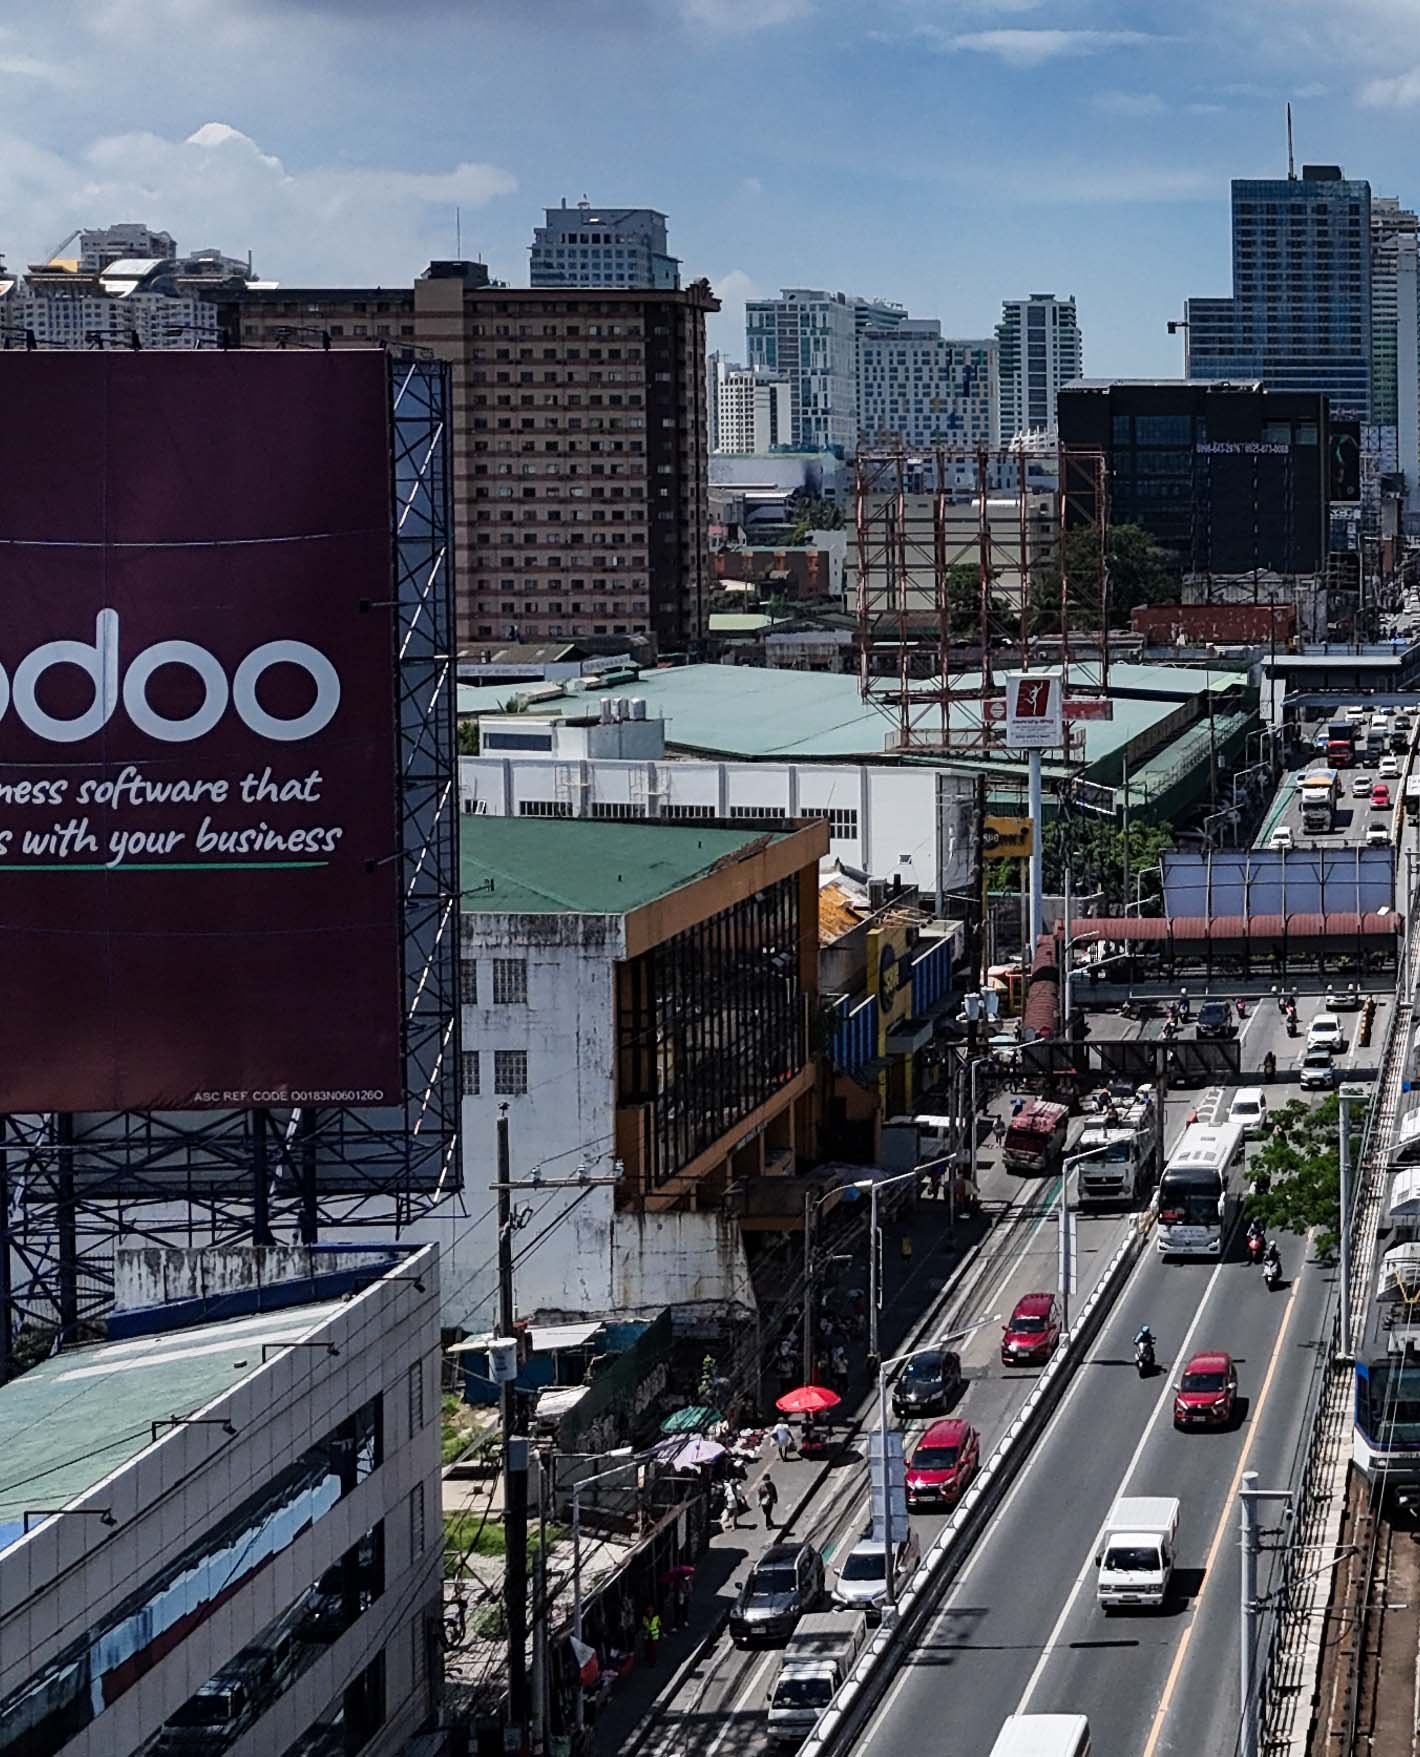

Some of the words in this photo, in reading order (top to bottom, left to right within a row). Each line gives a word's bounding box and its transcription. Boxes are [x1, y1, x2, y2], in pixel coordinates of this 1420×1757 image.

[0, 608, 341, 742] doo
[76, 766, 229, 811] software
[239, 766, 323, 804] that
[22, 817, 99, 857] with
[105, 828, 186, 869] your
[195, 815, 343, 853] business
[194, 1091, 220, 1102] ASC
[252, 1090, 288, 1101] CODE
